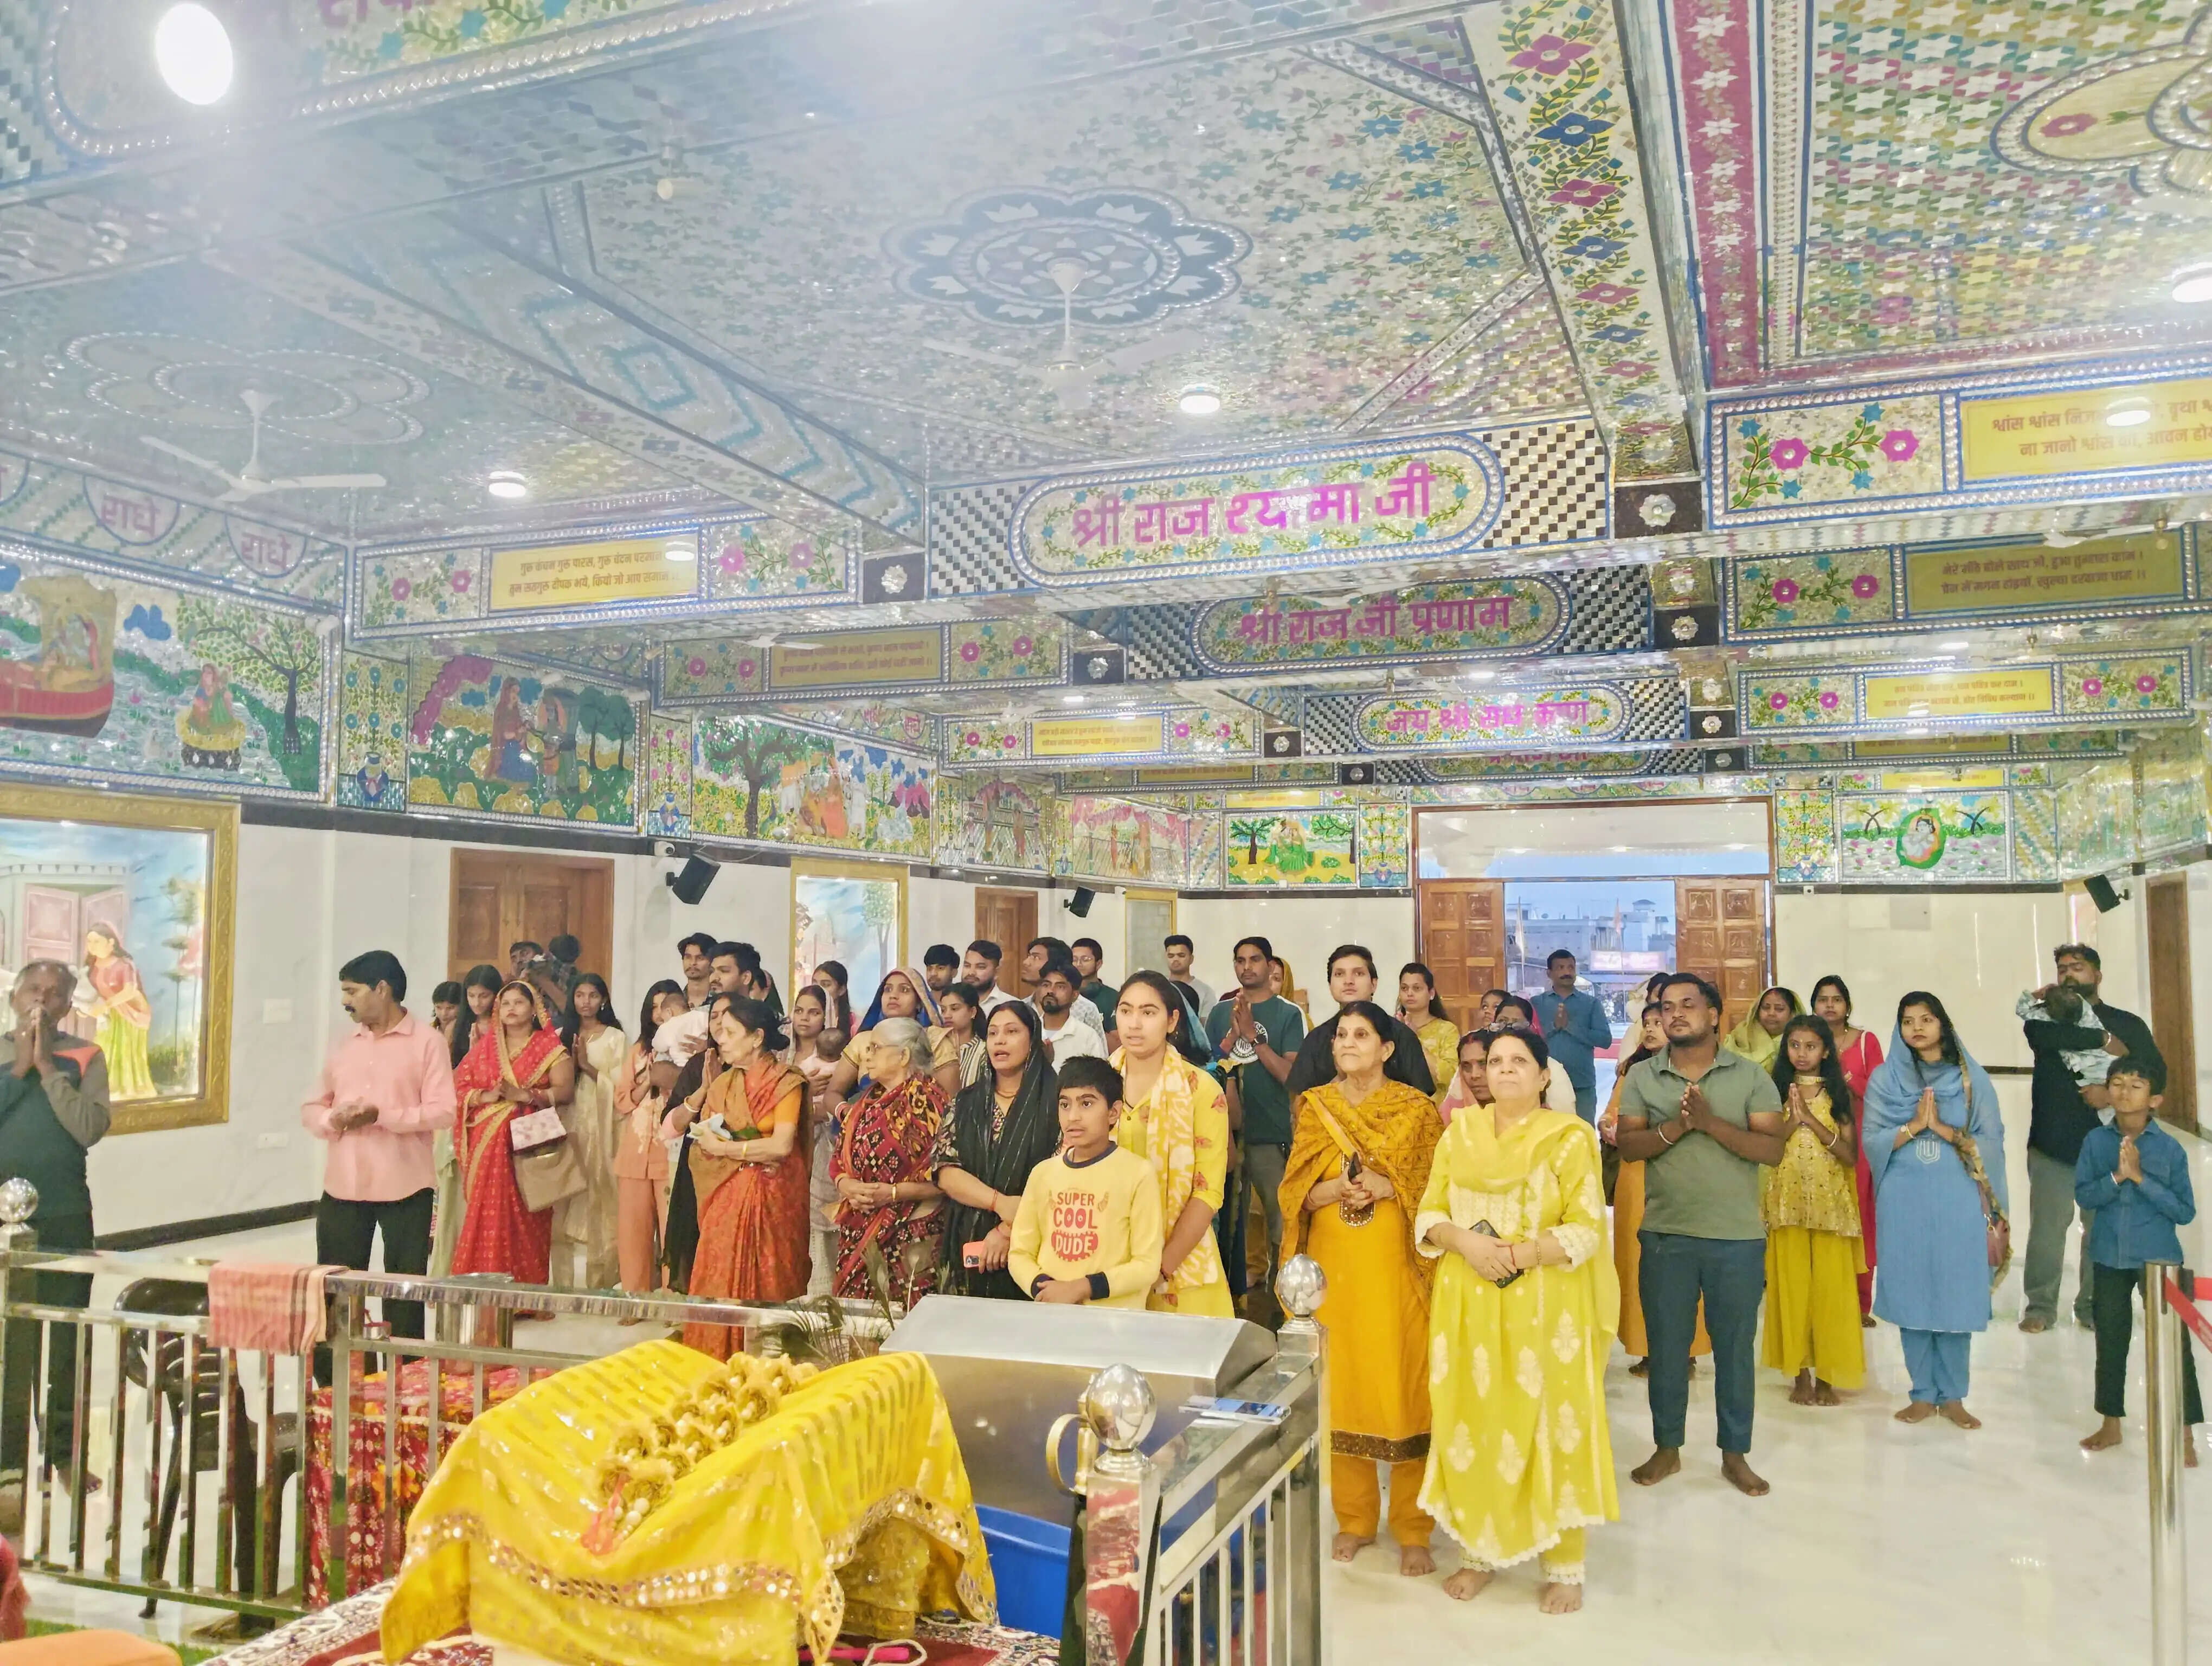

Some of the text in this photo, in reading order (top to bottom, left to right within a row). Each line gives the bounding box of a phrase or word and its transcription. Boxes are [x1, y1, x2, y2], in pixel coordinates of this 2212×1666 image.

[2019, 443, 2037, 456] ना
[2041, 435, 2077, 454] जानो
[1071, 492, 1126, 546] श्री
[1135, 496, 1216, 544] राज
[1375, 461, 1437, 518] जी
[1236, 594, 1514, 644] श्री राज जी प्रणाम
[1387, 709, 1430, 732] जय
[1438, 701, 1470, 731] श्री
[1057, 1192, 1095, 1207] SUPER
[1053, 1207, 1098, 1230] COOL
[1056, 1235, 1095, 1255] DUDE
